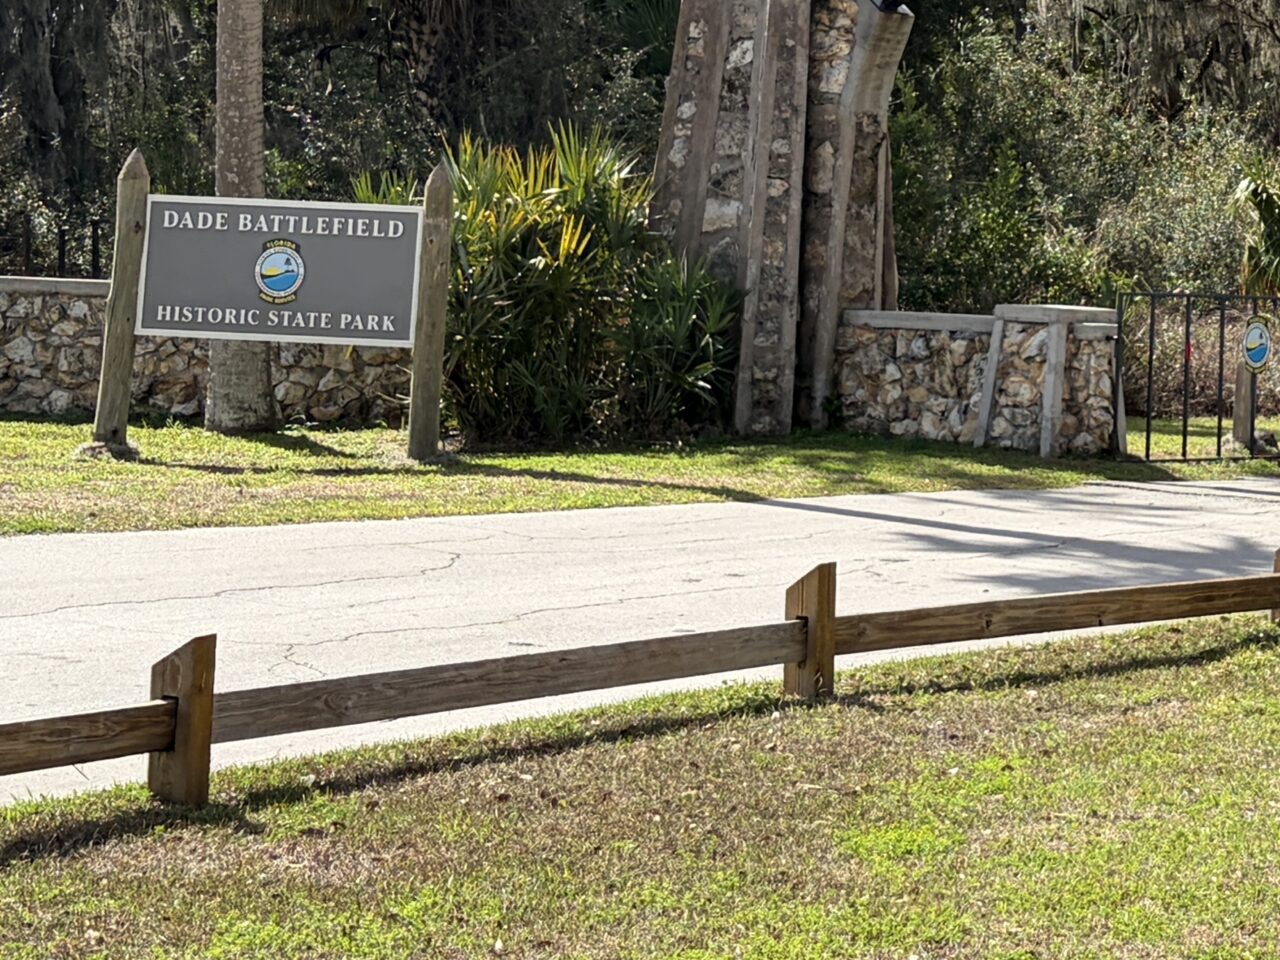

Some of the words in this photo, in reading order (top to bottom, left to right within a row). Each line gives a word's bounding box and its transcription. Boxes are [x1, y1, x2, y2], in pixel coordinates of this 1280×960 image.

[163, 209, 229, 230] DADE
[238, 213, 405, 238] BATTLEFIELD
[157, 305, 260, 325] HISTORIC
[267, 310, 332, 329] STATE
[340, 313, 396, 331] PARK
